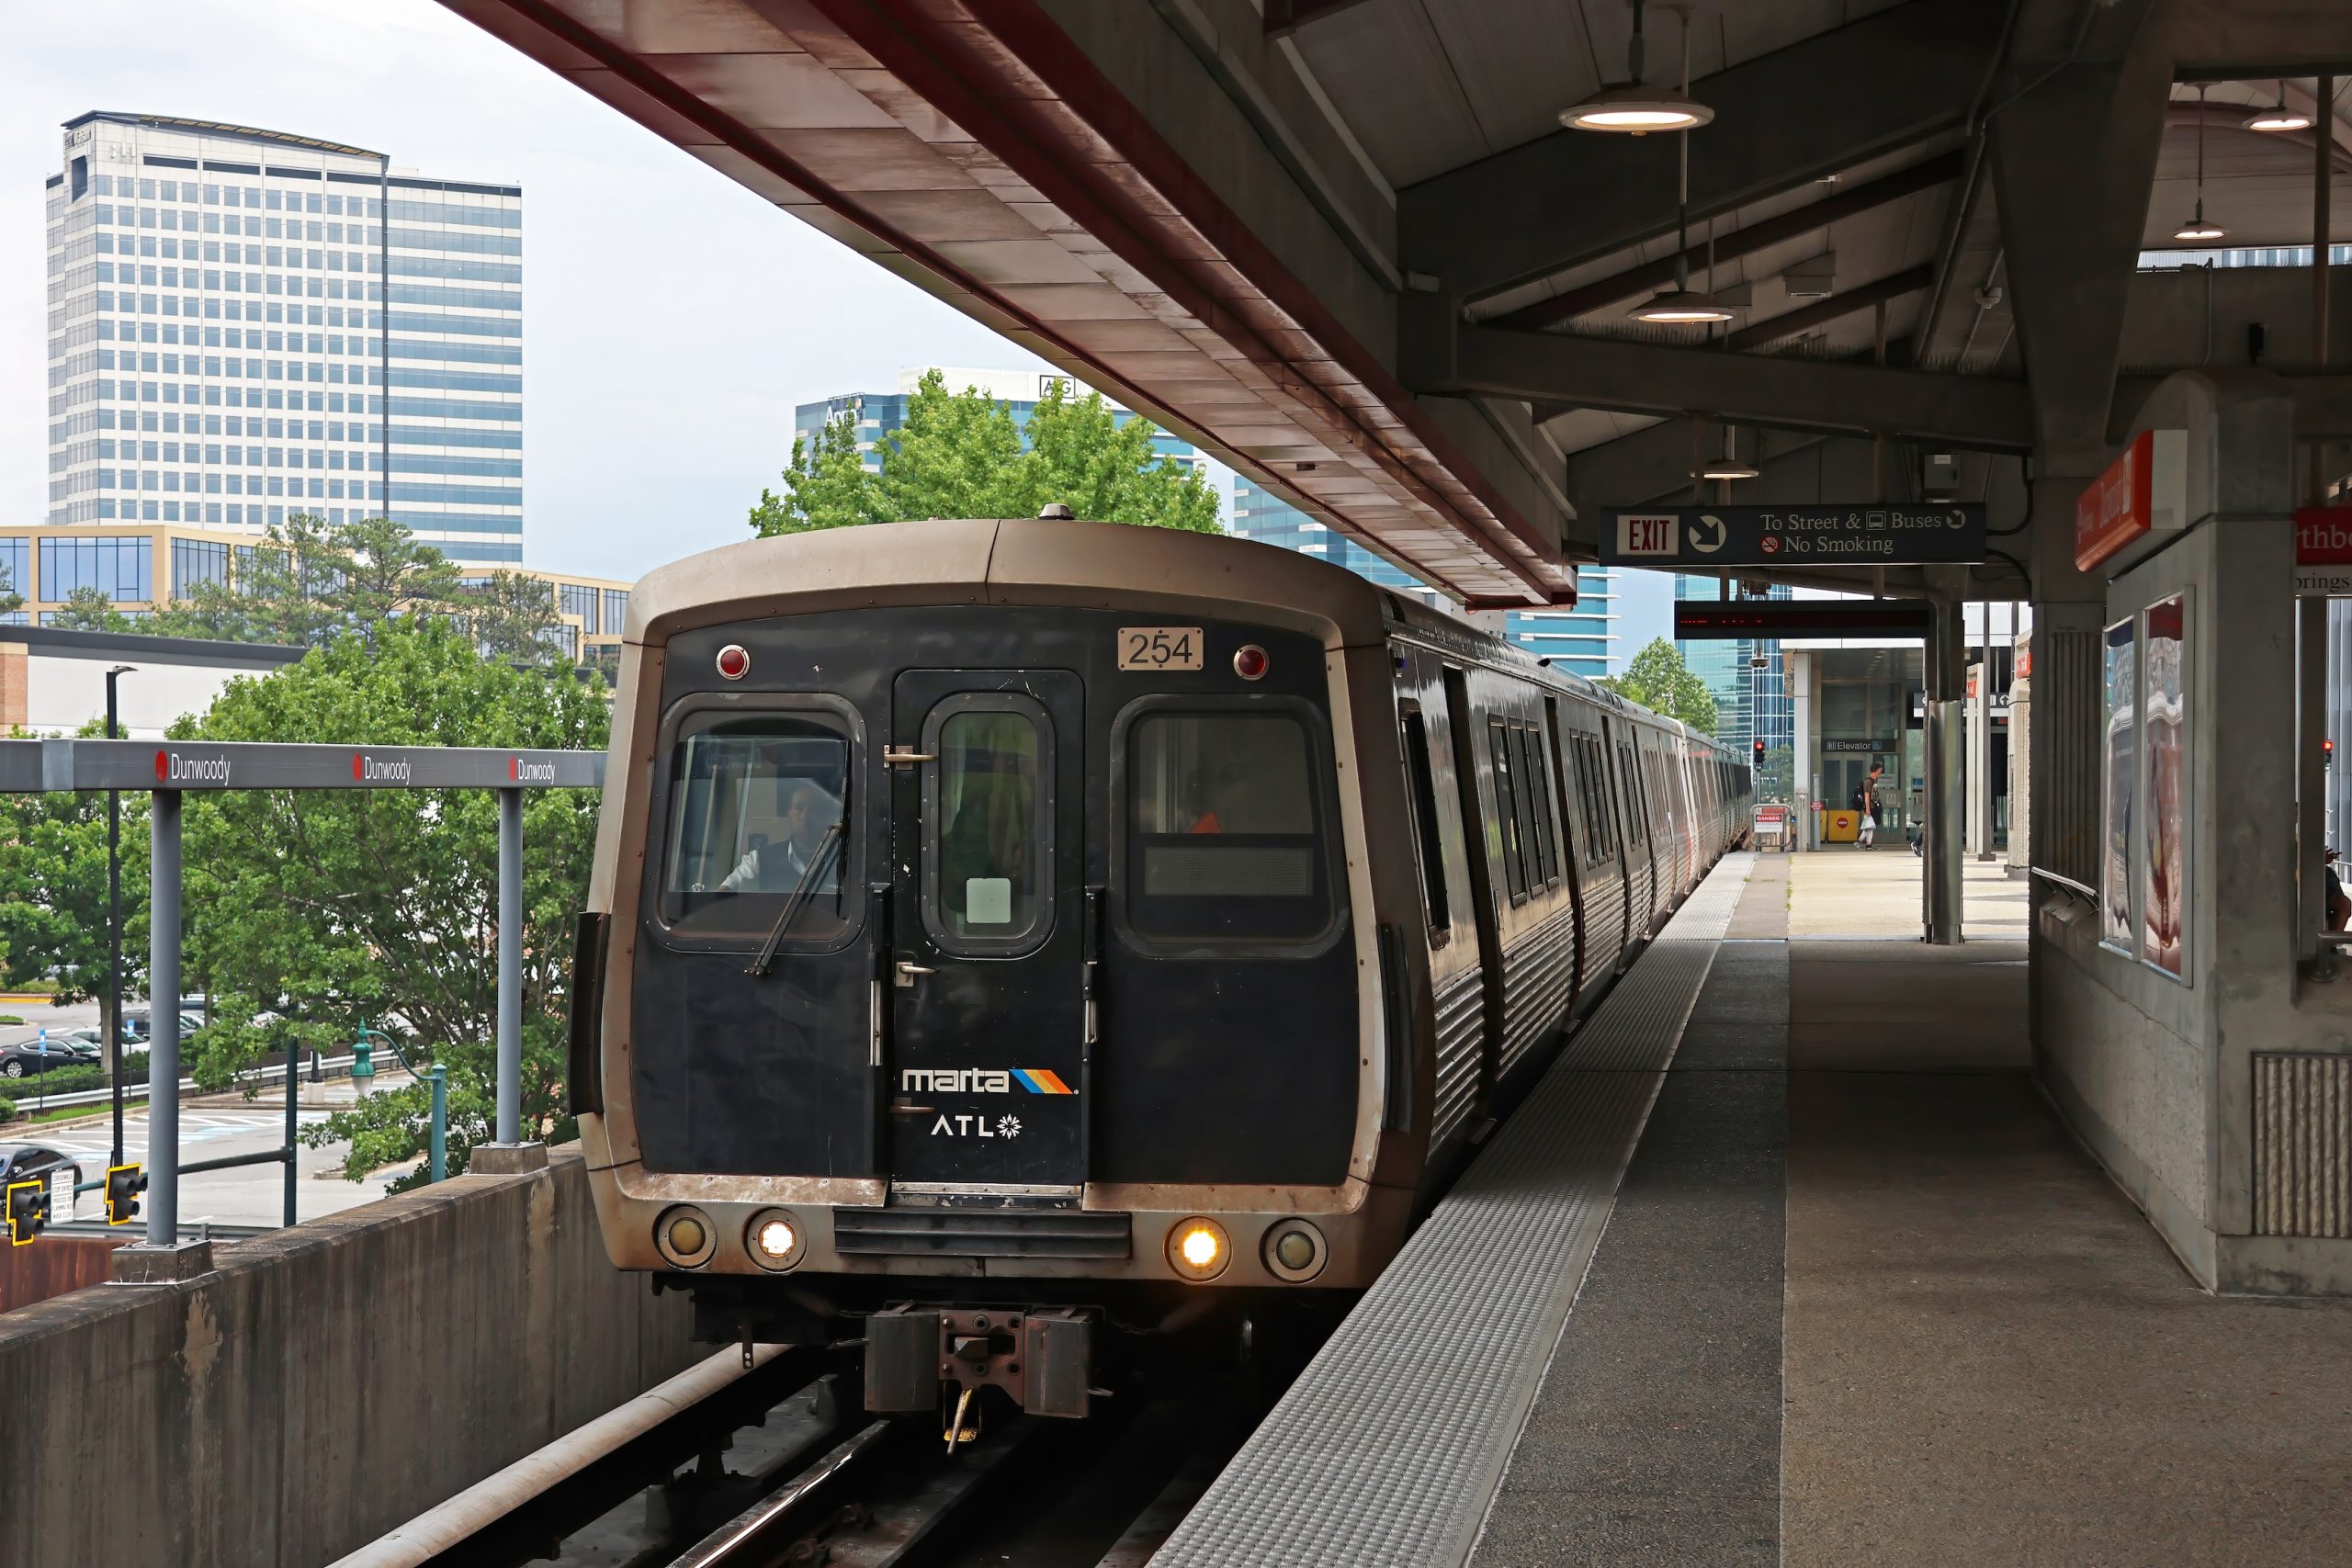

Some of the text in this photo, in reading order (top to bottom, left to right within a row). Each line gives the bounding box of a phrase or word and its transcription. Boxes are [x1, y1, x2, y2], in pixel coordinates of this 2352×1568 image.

[1044, 379, 1072, 395] AG
[1760, 513, 1941, 531] To Street & Buses
[1629, 520, 1670, 551] EXIT
[1784, 536, 1894, 555] No Smoking
[1128, 634, 1193, 663] 254
[1837, 741, 1871, 750] Elevator
[171, 753, 231, 785] Dunwoody
[365, 756, 412, 785] Dunwoody
[518, 759, 556, 784] Dunwoody
[902, 1067, 1010, 1093] marta
[931, 1114, 994, 1137] ATL
